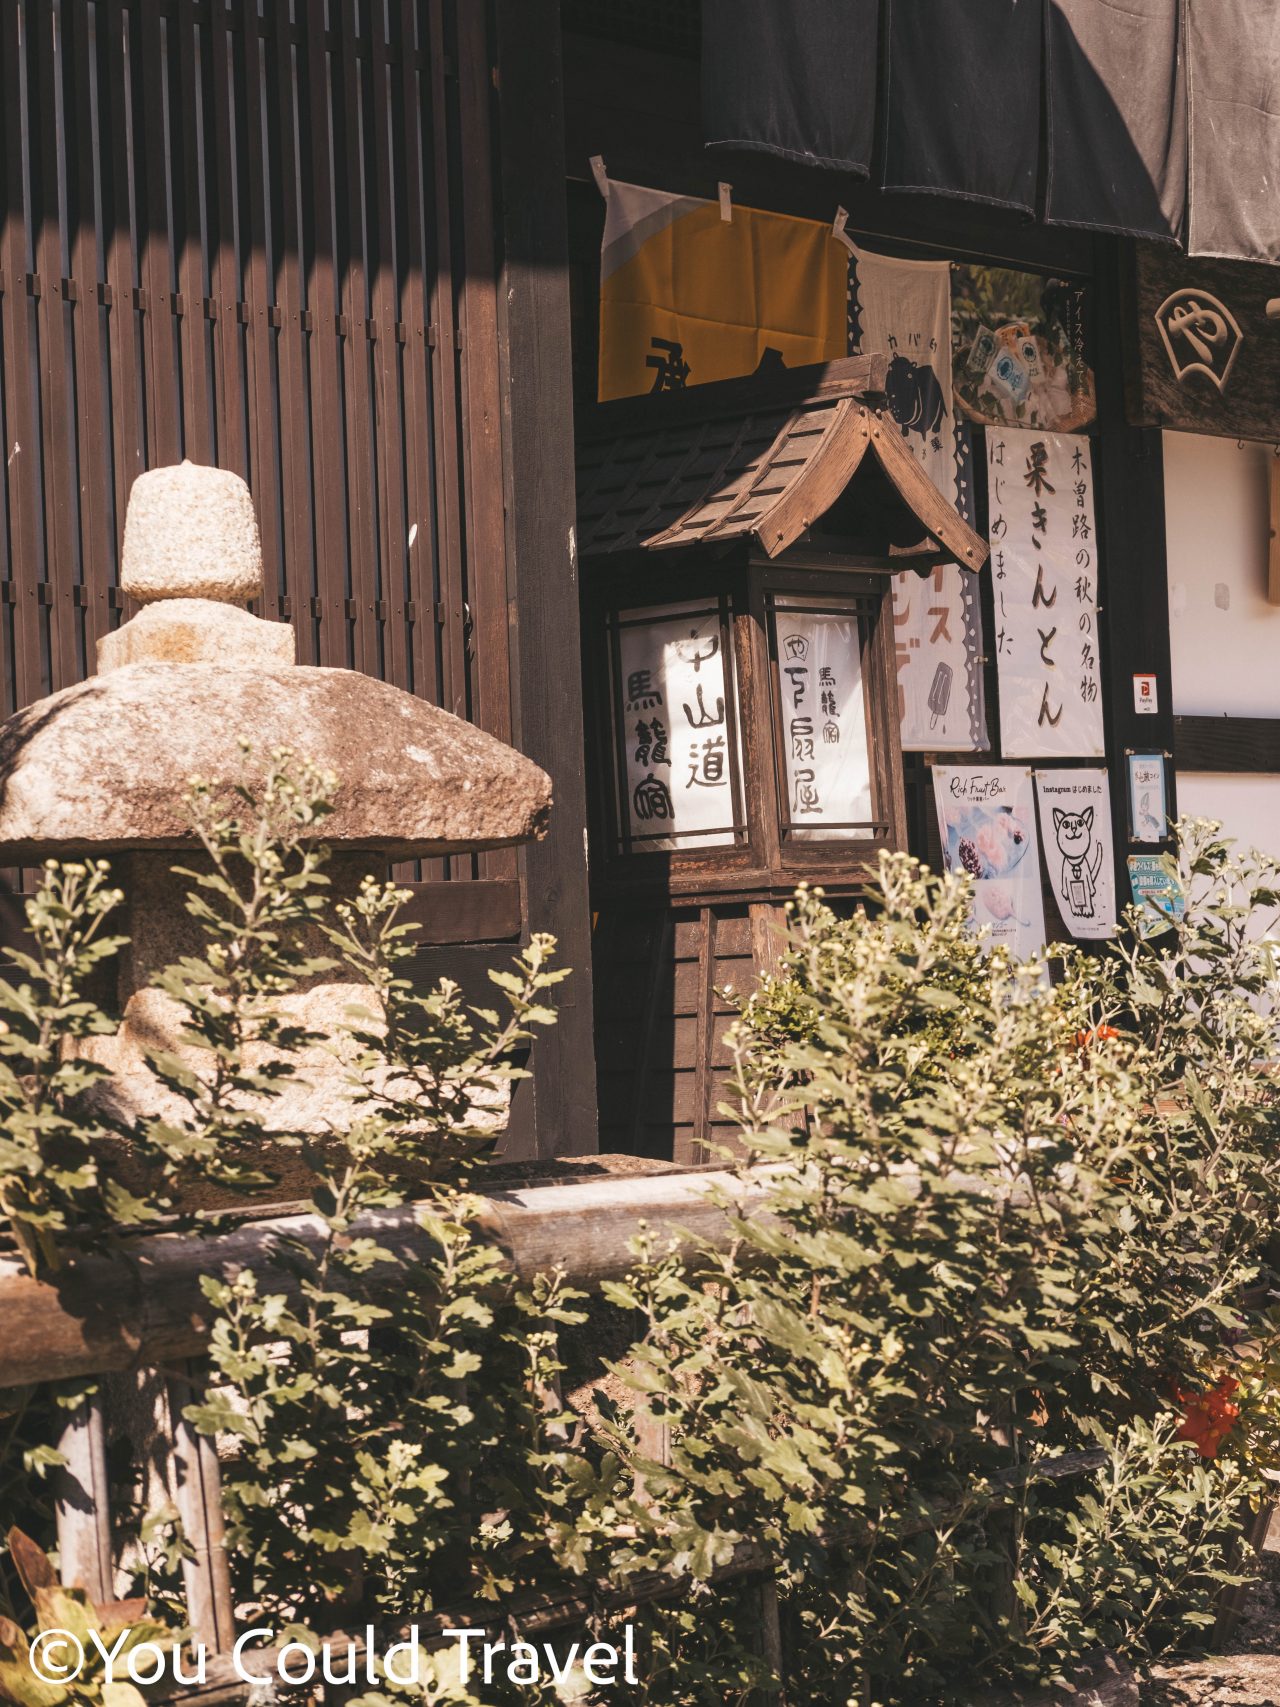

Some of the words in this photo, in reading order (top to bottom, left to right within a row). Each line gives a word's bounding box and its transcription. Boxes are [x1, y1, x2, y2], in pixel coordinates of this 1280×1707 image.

[989, 441, 1014, 656] はじめました
[1023, 441, 1063, 728] 栗きんとん
[1070, 446, 1098, 704] 木曽路の秋の名物
[626, 670, 675, 820] 馬籠宿
[678, 629, 728, 789] 中山道
[818, 666, 841, 745] 馬籠宿
[949, 776, 968, 799] Rich
[989, 777, 1007, 797] Bar
[1043, 785, 1071, 794] Instagram
[1073, 785, 1102, 794] はじめました
